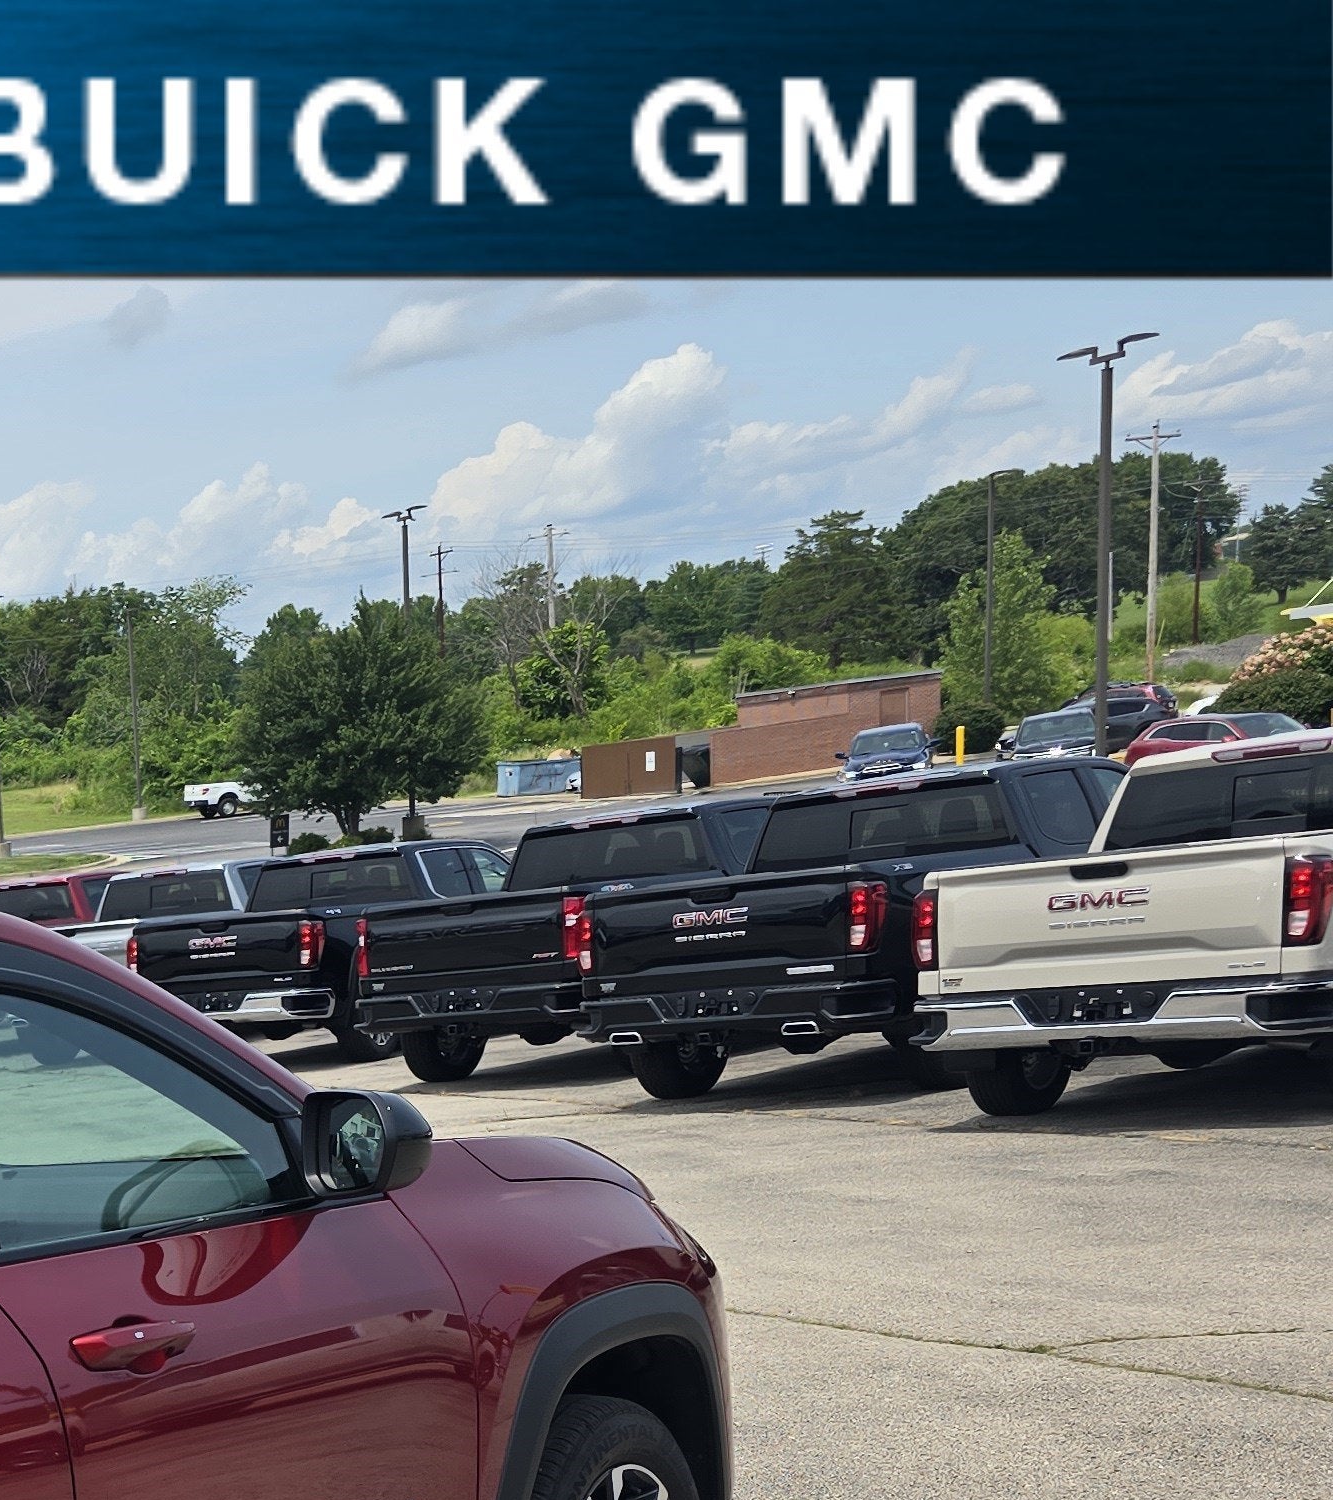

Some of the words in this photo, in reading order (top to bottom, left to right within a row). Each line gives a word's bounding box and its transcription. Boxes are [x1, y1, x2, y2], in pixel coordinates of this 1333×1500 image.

[1047, 887, 1150, 912] GMC
[672, 907, 748, 928] GMC
[188, 935, 237, 950] GMC
